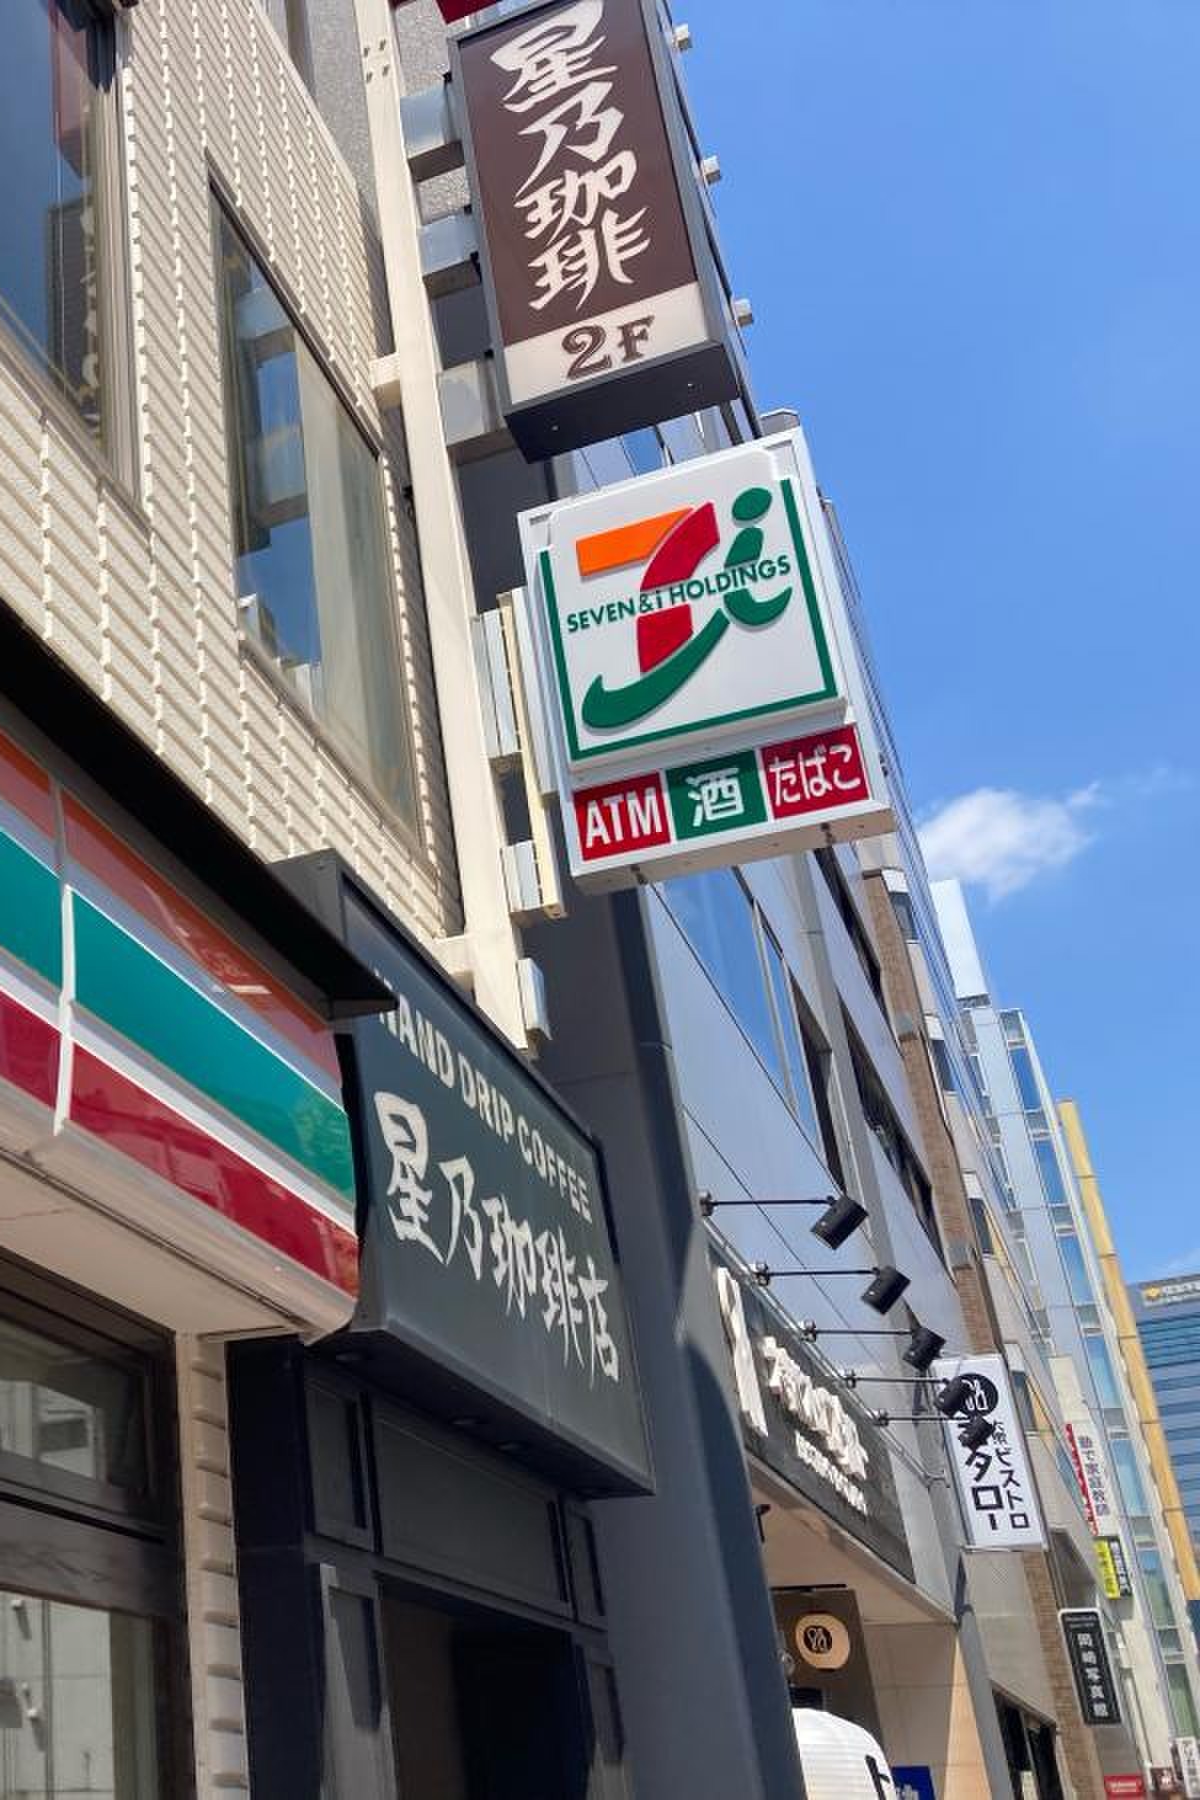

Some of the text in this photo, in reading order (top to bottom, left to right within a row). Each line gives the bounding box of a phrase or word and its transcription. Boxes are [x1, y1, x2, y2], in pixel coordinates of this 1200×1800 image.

[490, 0, 651, 310] 星乃珈琲
[562, 315, 656, 381] 2F
[670, 555, 792, 605] HOLDINGS
[685, 767, 745, 827] 酒
[768, 744, 861, 807] たばこ
[586, 787, 663, 849] ATM
[458, 1053, 514, 1143] DRIP
[517, 1116, 593, 1224] COFFEE
[374, 1092, 620, 1389] 星乃珈琲店
